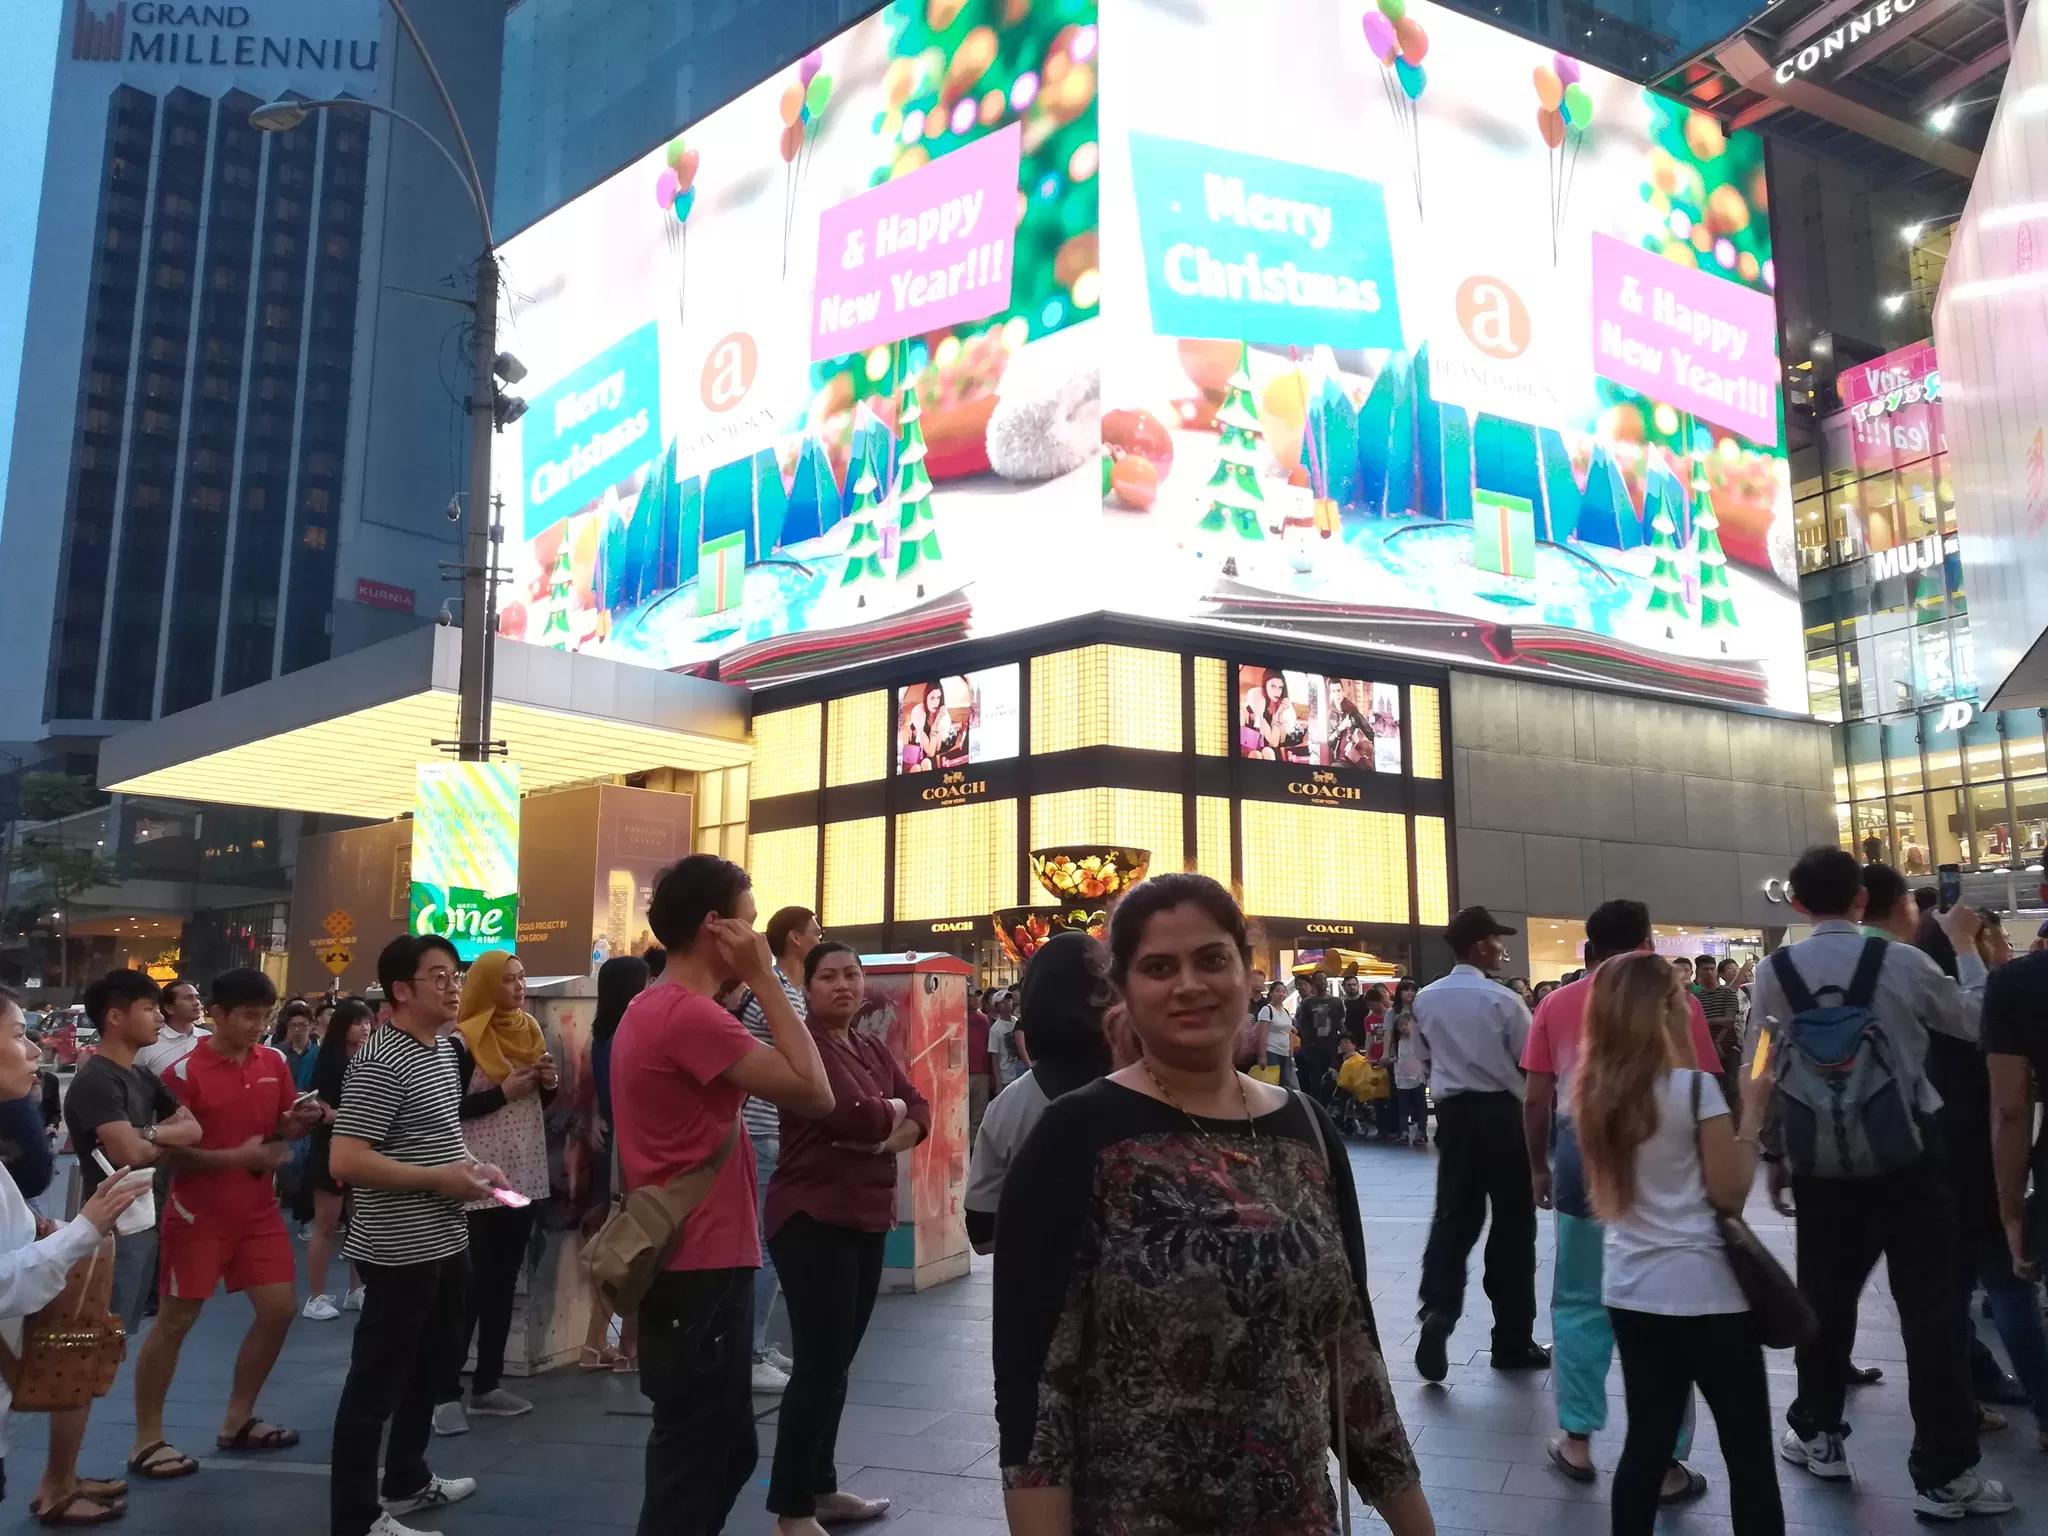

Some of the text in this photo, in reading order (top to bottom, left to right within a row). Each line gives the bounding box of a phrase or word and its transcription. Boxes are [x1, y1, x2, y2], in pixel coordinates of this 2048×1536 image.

[131, 2, 250, 29] GRAND
[128, 31, 380, 72] MILLENNIU
[841, 189, 985, 270] & Happy
[1203, 171, 1333, 250] Merry
[819, 239, 1005, 336] New Year!!!
[1163, 243, 1382, 313] Christmas
[1619, 275, 1748, 361] & Happy
[1601, 319, 1769, 420] New Year!!!
[554, 369, 625, 438] Merry
[531, 408, 649, 505] Christmas
[1874, 535, 1944, 581] MUJI
[359, 586, 413, 606] KURNIA
[1936, 700, 1973, 733] JD
[922, 781, 986, 801] COACH
[1288, 782, 1361, 800] COACH
[416, 903, 503, 939] One
[535, 920, 560, 930] PROJECT
[560, 920, 568, 929] BY
[931, 921, 974, 933] COACH
[1306, 923, 1354, 935] COACH
